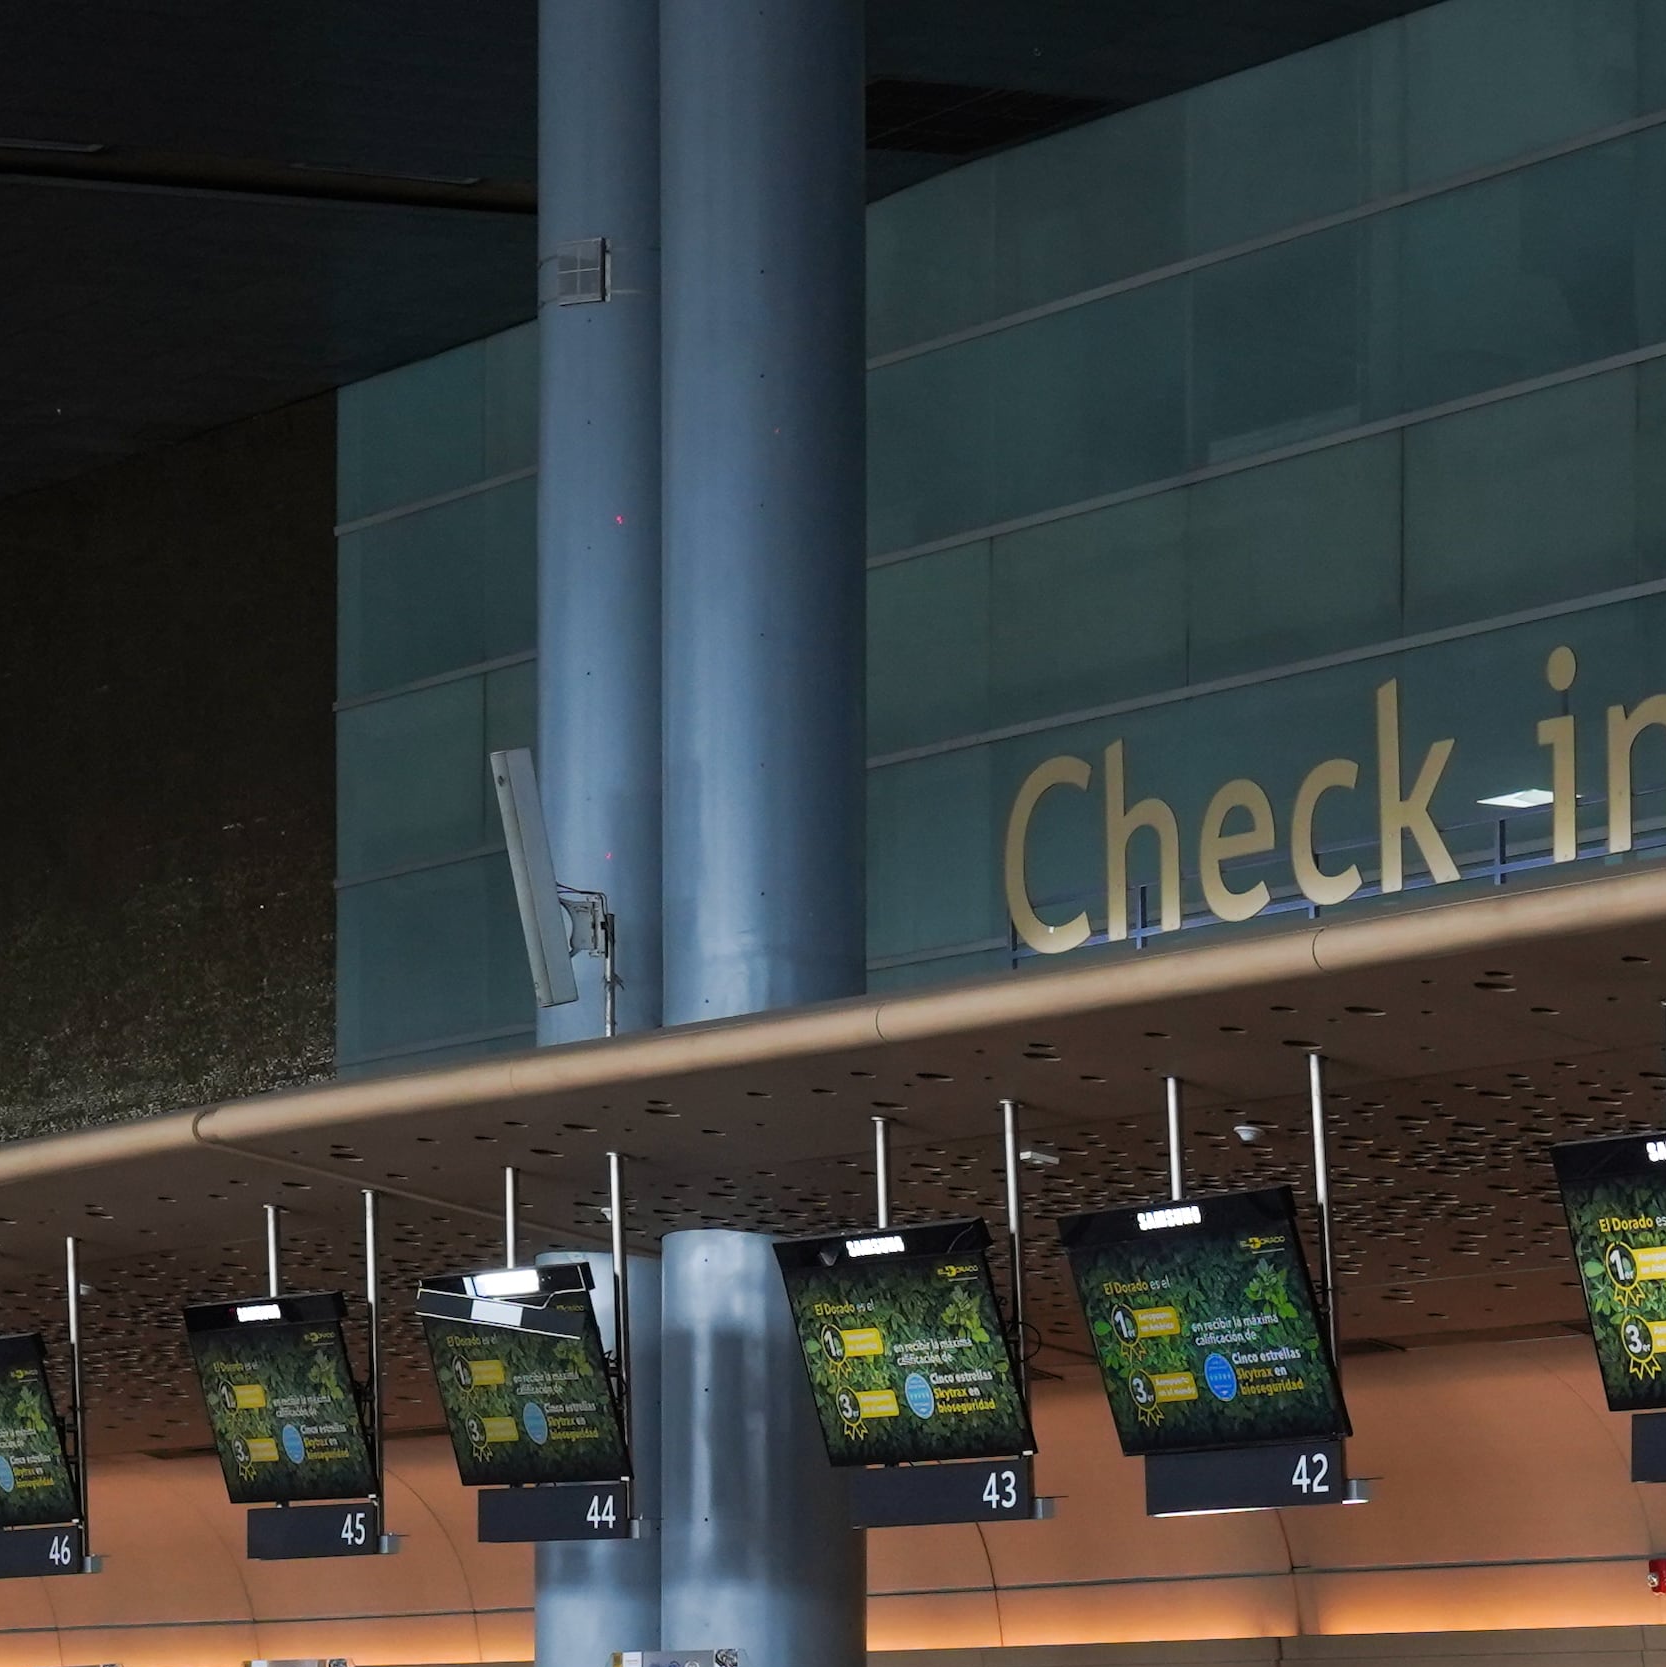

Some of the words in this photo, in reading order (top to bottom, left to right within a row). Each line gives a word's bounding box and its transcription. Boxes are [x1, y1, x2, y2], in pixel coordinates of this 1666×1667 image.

[1005, 677, 1461, 954] Check
[1599, 1218, 1610, 1232] El
[1613, 1213, 1653, 1231] Dorado
[982, 1471, 1017, 1509] 43
[1292, 1453, 1329, 1494] 42
[341, 1513, 366, 1545] 45
[586, 1496, 616, 1529] 44
[49, 1536, 72, 1565] 46
